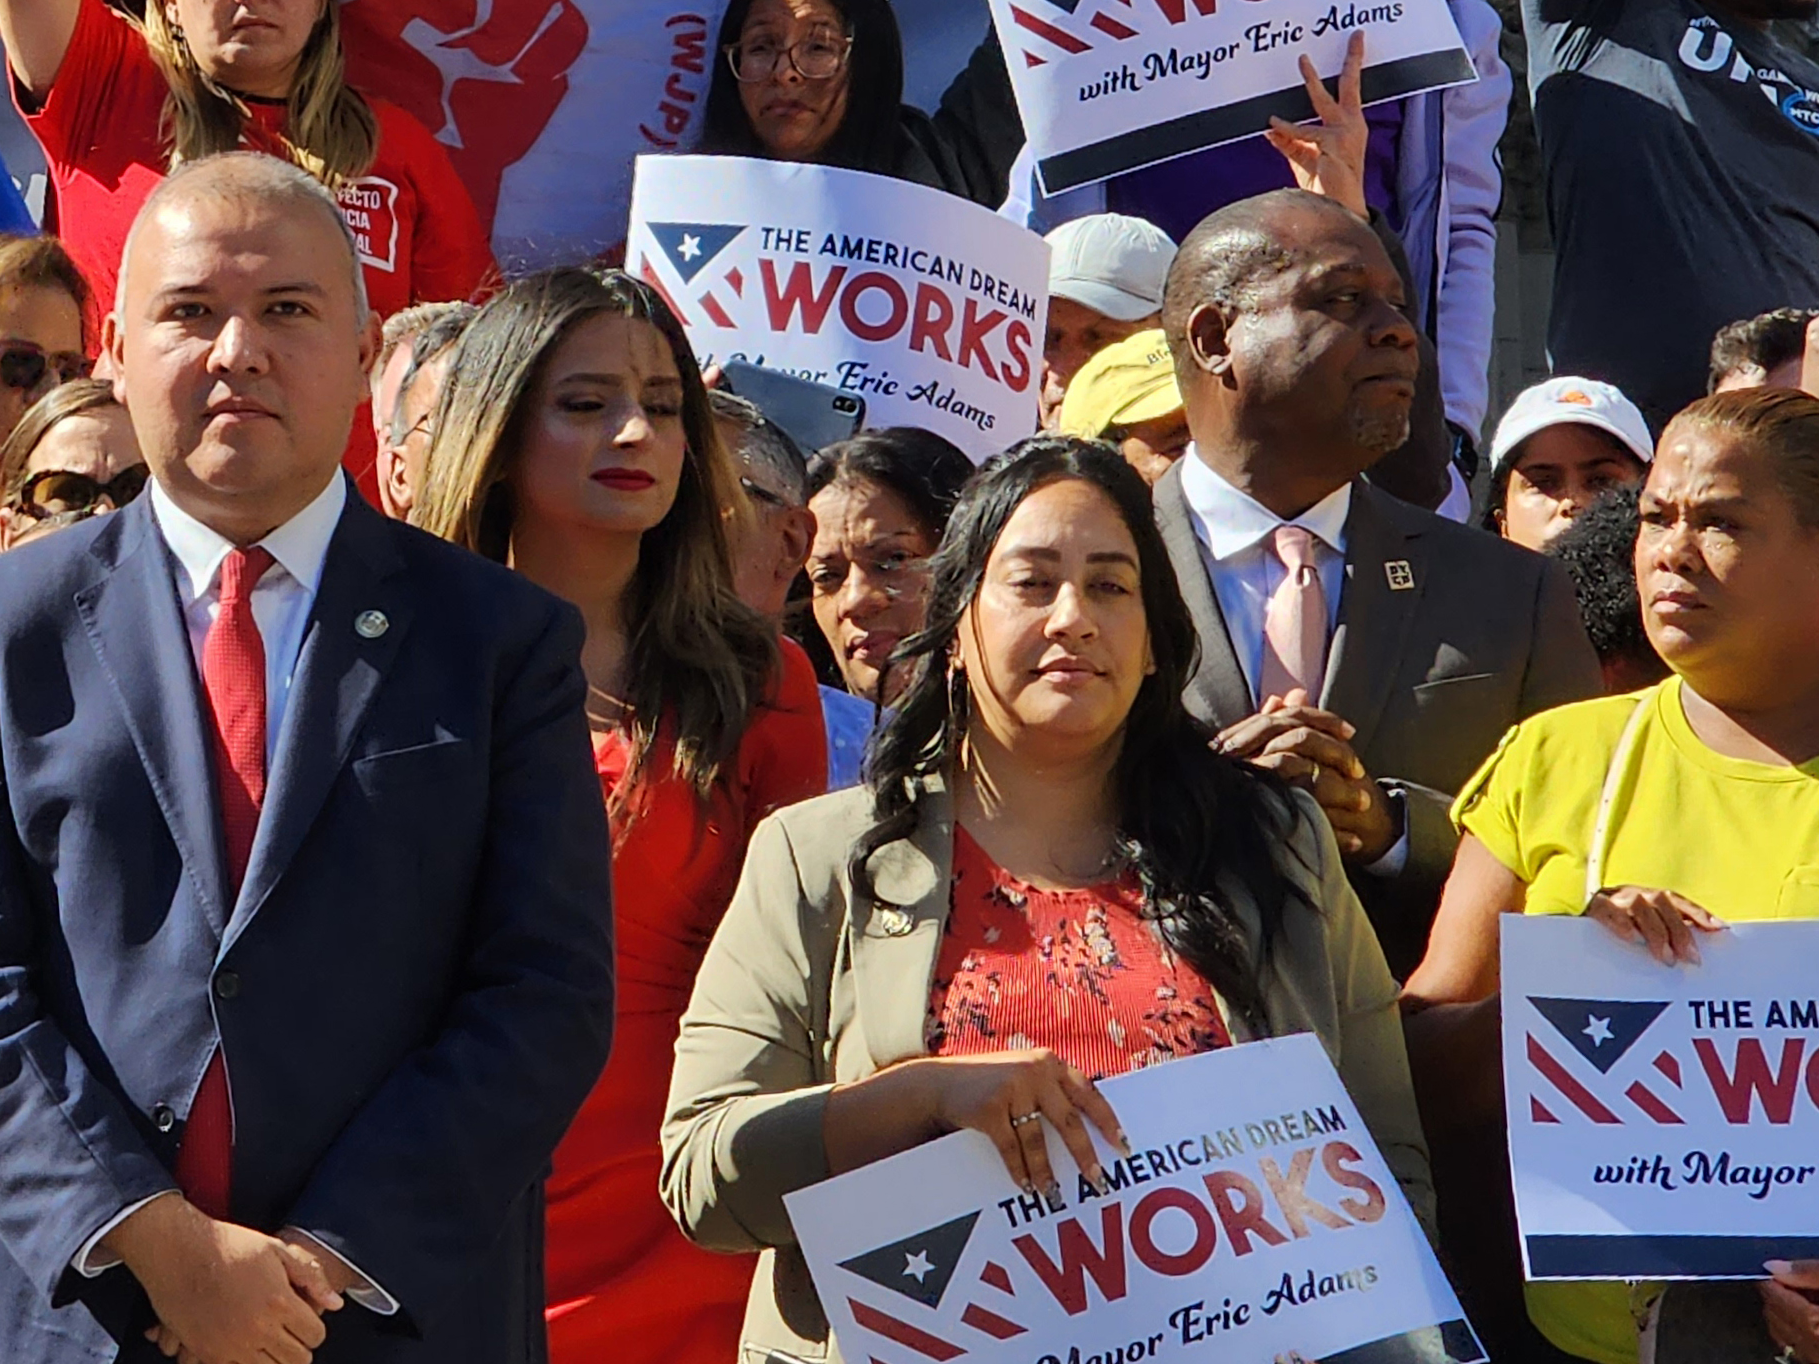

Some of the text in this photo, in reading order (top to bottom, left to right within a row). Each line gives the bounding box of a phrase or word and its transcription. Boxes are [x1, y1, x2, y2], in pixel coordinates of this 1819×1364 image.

[1078, 1, 1404, 102] with Mayor Eric Adams
[761, 227, 1037, 321] THE AMERICAN DREAM
[758, 258, 1032, 393] WORKS
[836, 360, 898, 396] Eric
[905, 379, 996, 432] Adams
[1688, 1000, 1754, 1029] THE
[1691, 1037, 1819, 1124] W
[1077, 1126, 1245, 1205] AMERICAN
[1251, 1103, 1349, 1150] DREAM
[1594, 1150, 1816, 1201] with Mayor
[1011, 1139, 1388, 1318] WORKS
[1168, 1298, 1251, 1346] Eric
[1260, 1263, 1378, 1316] Adams
